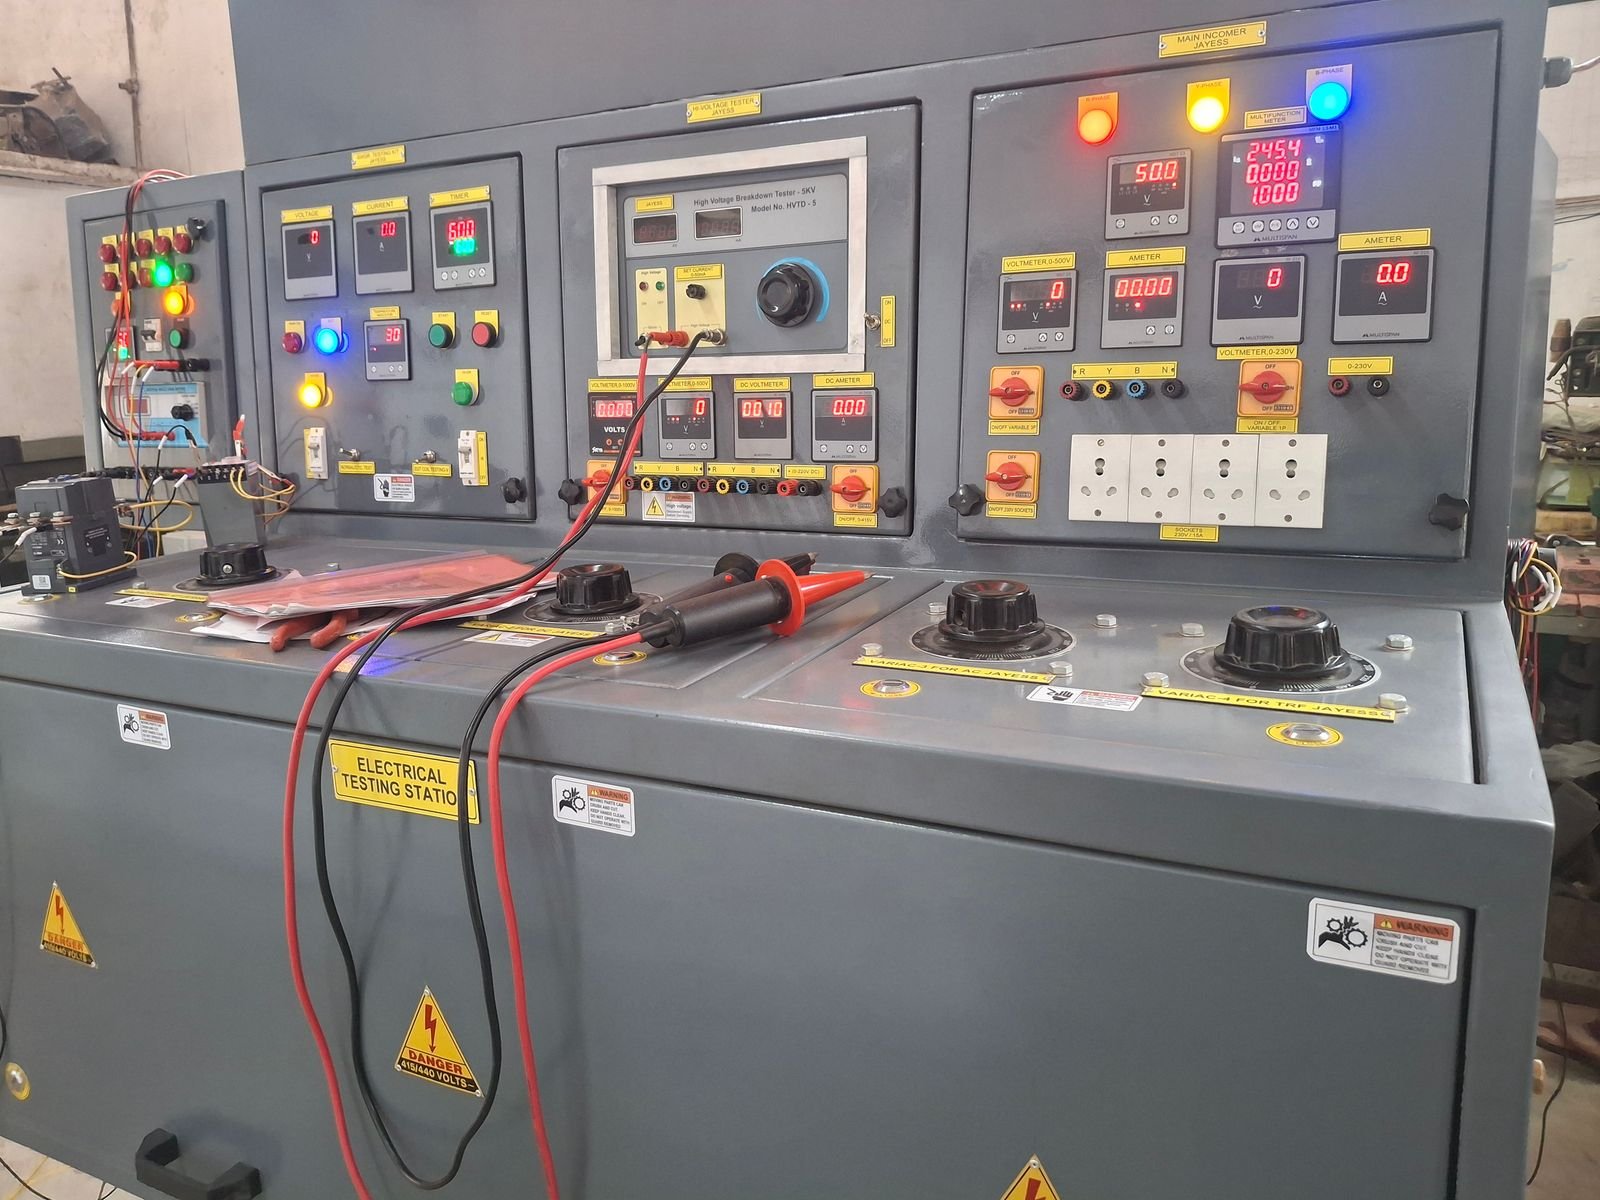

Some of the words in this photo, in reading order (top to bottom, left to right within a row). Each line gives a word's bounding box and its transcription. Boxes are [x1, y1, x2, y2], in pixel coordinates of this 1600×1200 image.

[1177, 34, 1200, 43] MAIN
[1202, 28, 1247, 40] INCOMER
[1193, 39, 1229, 49] JAYESS
[730, 98, 754, 106] TESTER
[712, 107, 735, 116] JAYESS
[1250, 110, 1301, 120] MULTIFUNCTION
[449, 191, 469, 200] TIMER
[710, 195, 734, 205] Voltage
[735, 192, 773, 202] Breakdown
[775, 189, 796, 197] Tester
[801, 186, 816, 195] 5KV
[366, 201, 394, 210] CURRENT
[751, 204, 772, 213] Model
[773, 203, 785, 211] No.
[786, 200, 806, 209] HVTD
[310, 230, 319, 244] 0
[1364, 235, 1402, 244] AMETER
[1128, 253, 1161, 262] AMETER
[1267, 268, 1281, 287] 0
[1051, 281, 1064, 299] 0
[1254, 295, 1262, 305] V
[1378, 291, 1387, 302] A
[1032, 312, 1039, 320] V
[386, 328, 400, 342] 30
[1219, 347, 1295, 357] VOLTMETER,0-230V
[696, 400, 705, 415] 0
[985, 671, 1040, 680] JAYESS
[1158, 690, 1230, 701] VARIAC-4
[1237, 697, 1270, 706] FOR
[1275, 700, 1307, 709] TRF
[1312, 706, 1378, 717] JAYESS
[357, 757, 447, 785] ELECTRICAL
[342, 773, 401, 796] TESTING
[405, 783, 457, 806] STATIO
[600, 790, 628, 801] WARNING
[1396, 920, 1449, 938] WARNING
[408, 1050, 463, 1075] DANGER
[401, 1060, 435, 1078] 415/440
[437, 1072, 467, 1088] VOLTS
